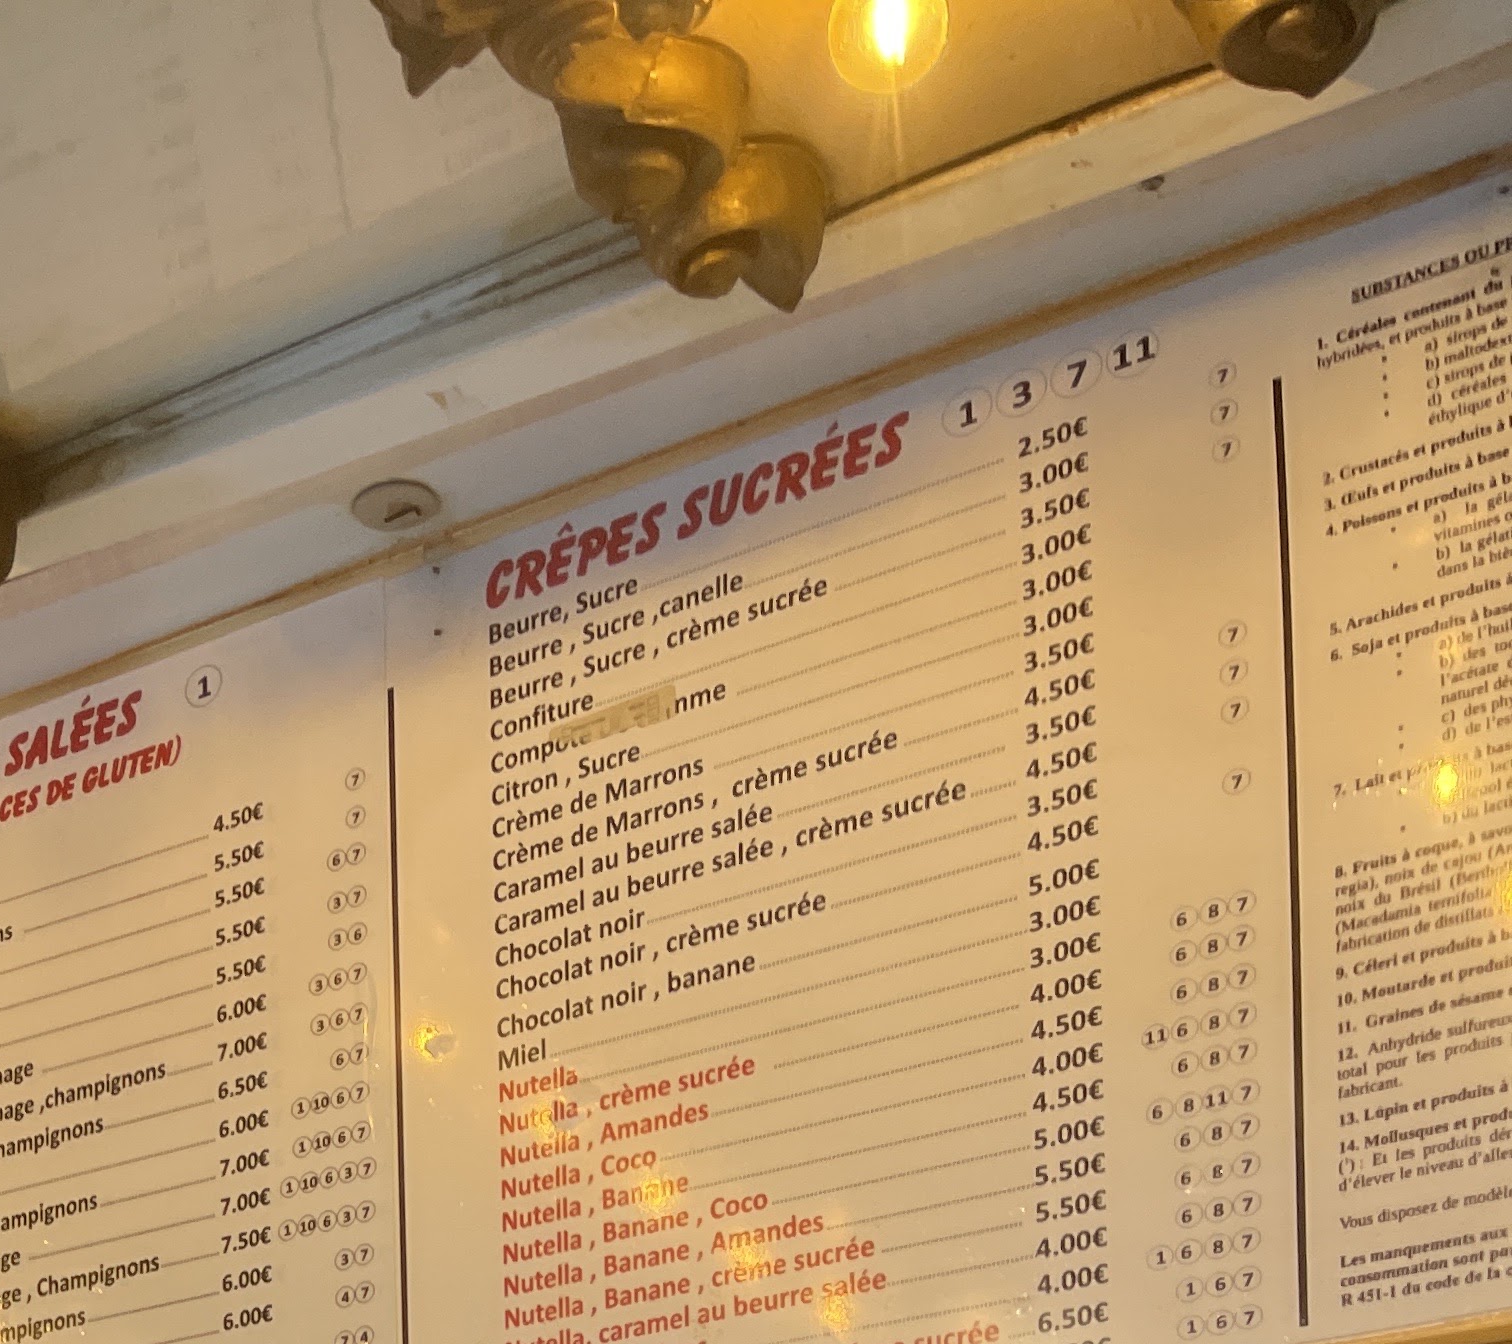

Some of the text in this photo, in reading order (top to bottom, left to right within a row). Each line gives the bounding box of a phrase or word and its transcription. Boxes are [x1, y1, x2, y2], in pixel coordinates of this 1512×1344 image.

[486, 335, 1156, 609] CRÊPES SUCRÉES 1 3 7 11
[488, 416, 1089, 645] Beurre, Sucre 2.50€
[491, 525, 1093, 742] Confiture 3.00€
[6, 690, 142, 772] SALÉES
[197, 677, 211, 699] 1
[46, 773, 77, 809] DE
[81, 735, 182, 795] GLUTEN)
[493, 633, 1095, 840] Crème de Marrons 3.50€
[213, 803, 264, 833] 4.50€
[214, 842, 265, 872] 5.50€
[215, 879, 265, 909] 5.50€
[495, 779, 1098, 969] Chocolat noir 3.50€
[1036, 1264, 1109, 1300] 4.00€
